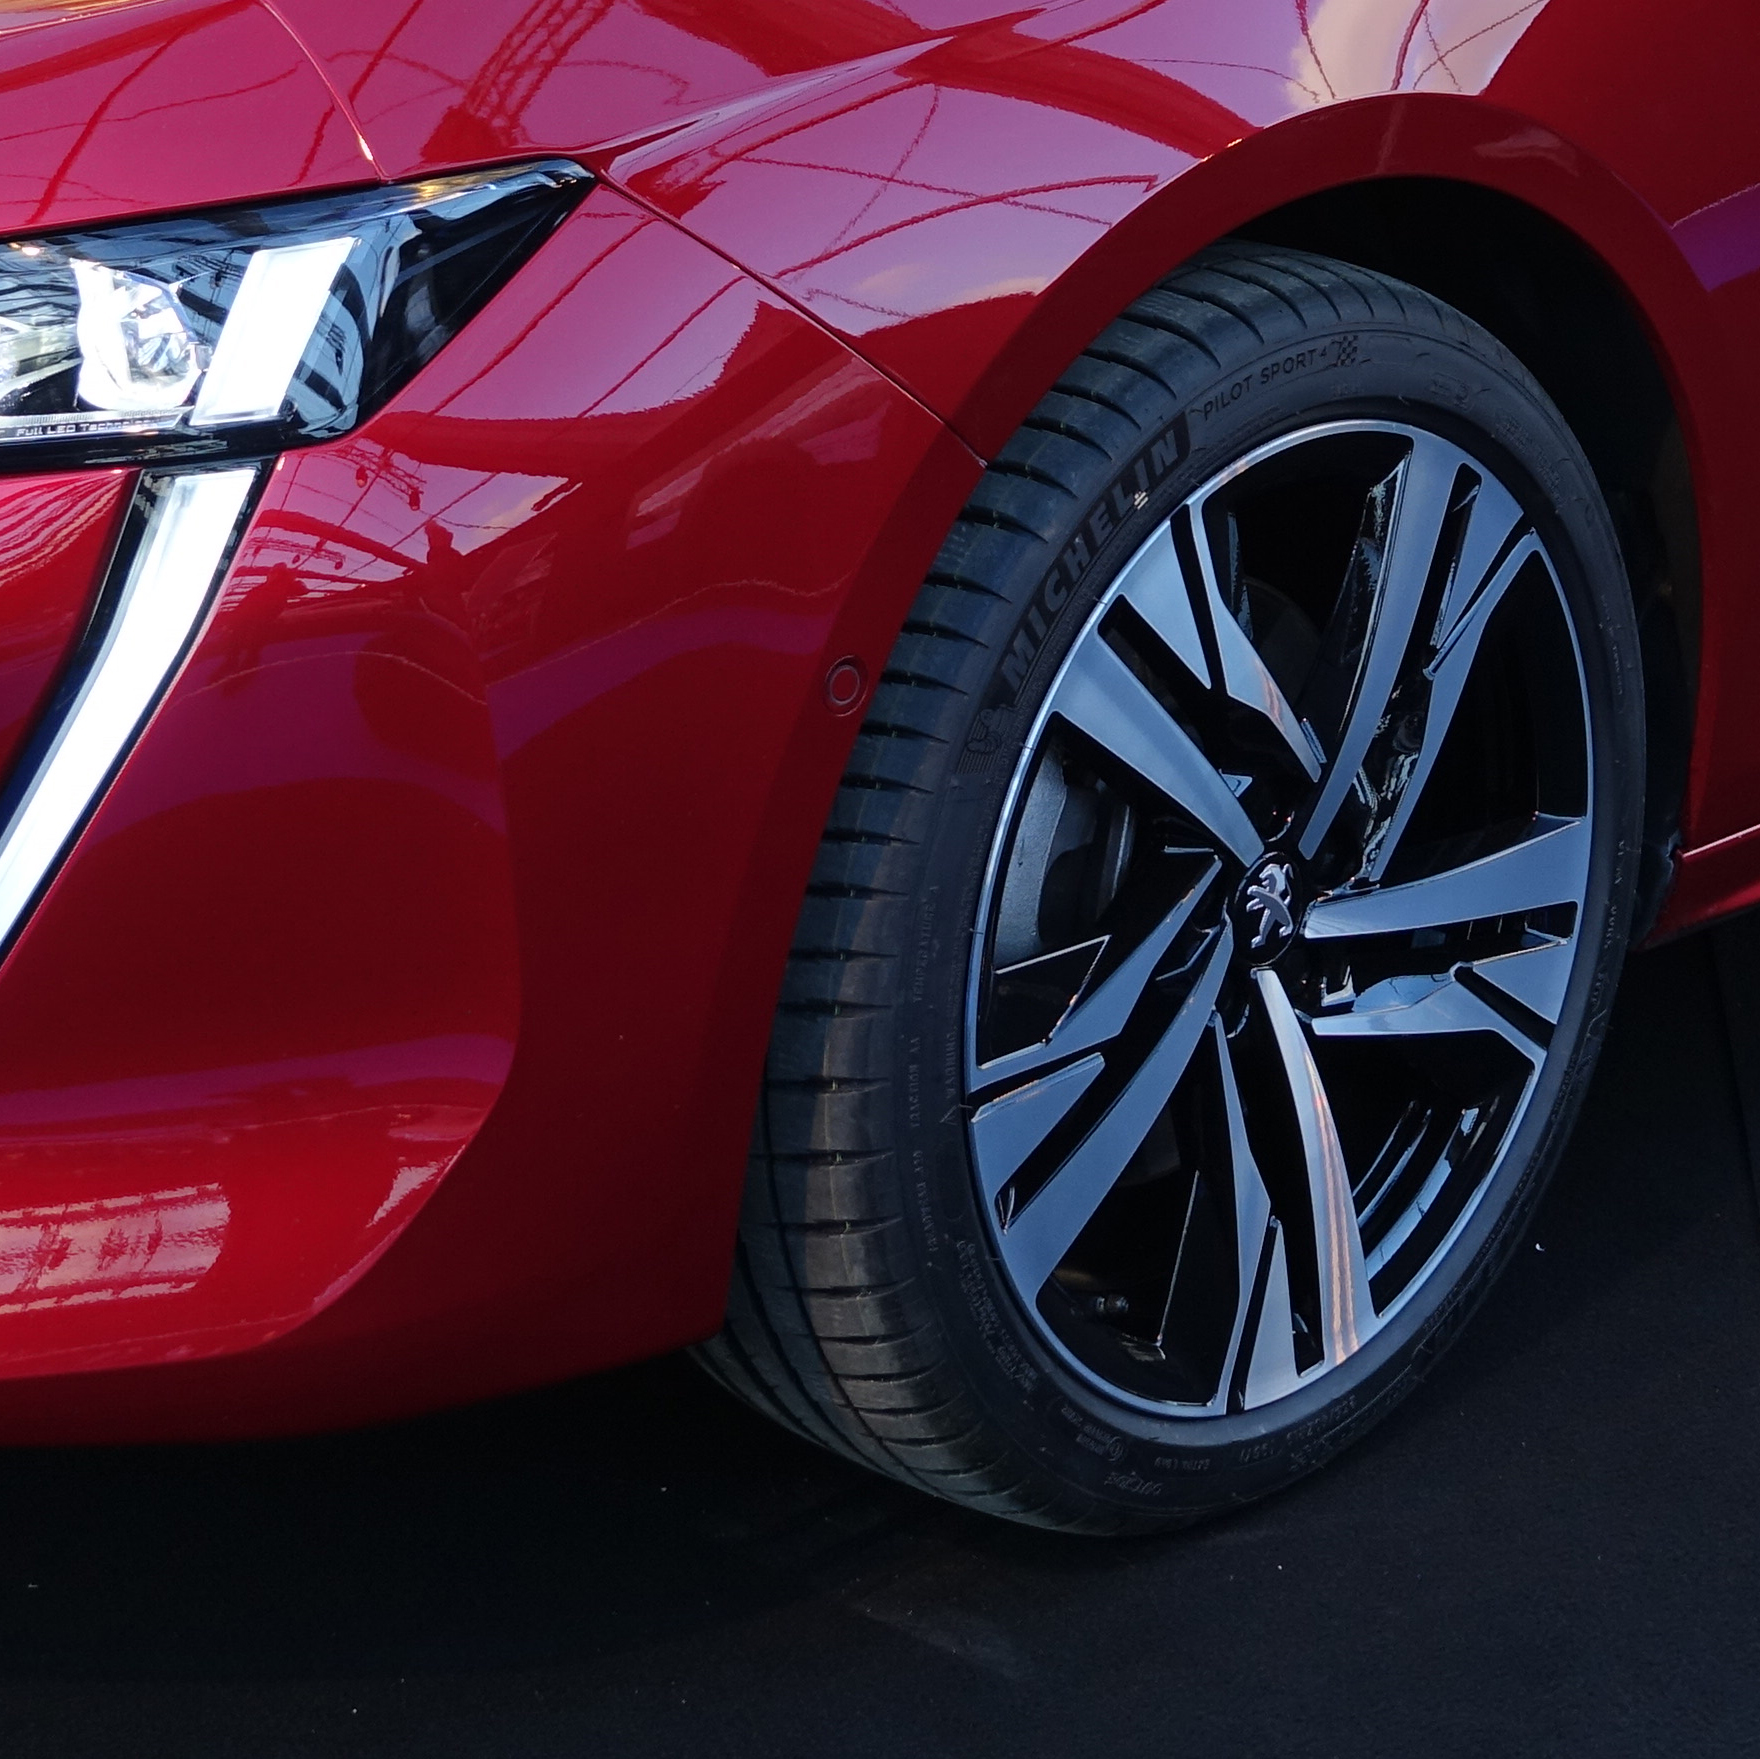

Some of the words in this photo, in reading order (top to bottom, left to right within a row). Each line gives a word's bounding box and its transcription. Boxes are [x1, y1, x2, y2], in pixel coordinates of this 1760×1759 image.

[1202, 375, 1253, 421] PILOT
[1260, 348, 1317, 385] SPORT
[47, 424, 76, 435] LED
[1001, 428, 1179, 692] MICHELIN
